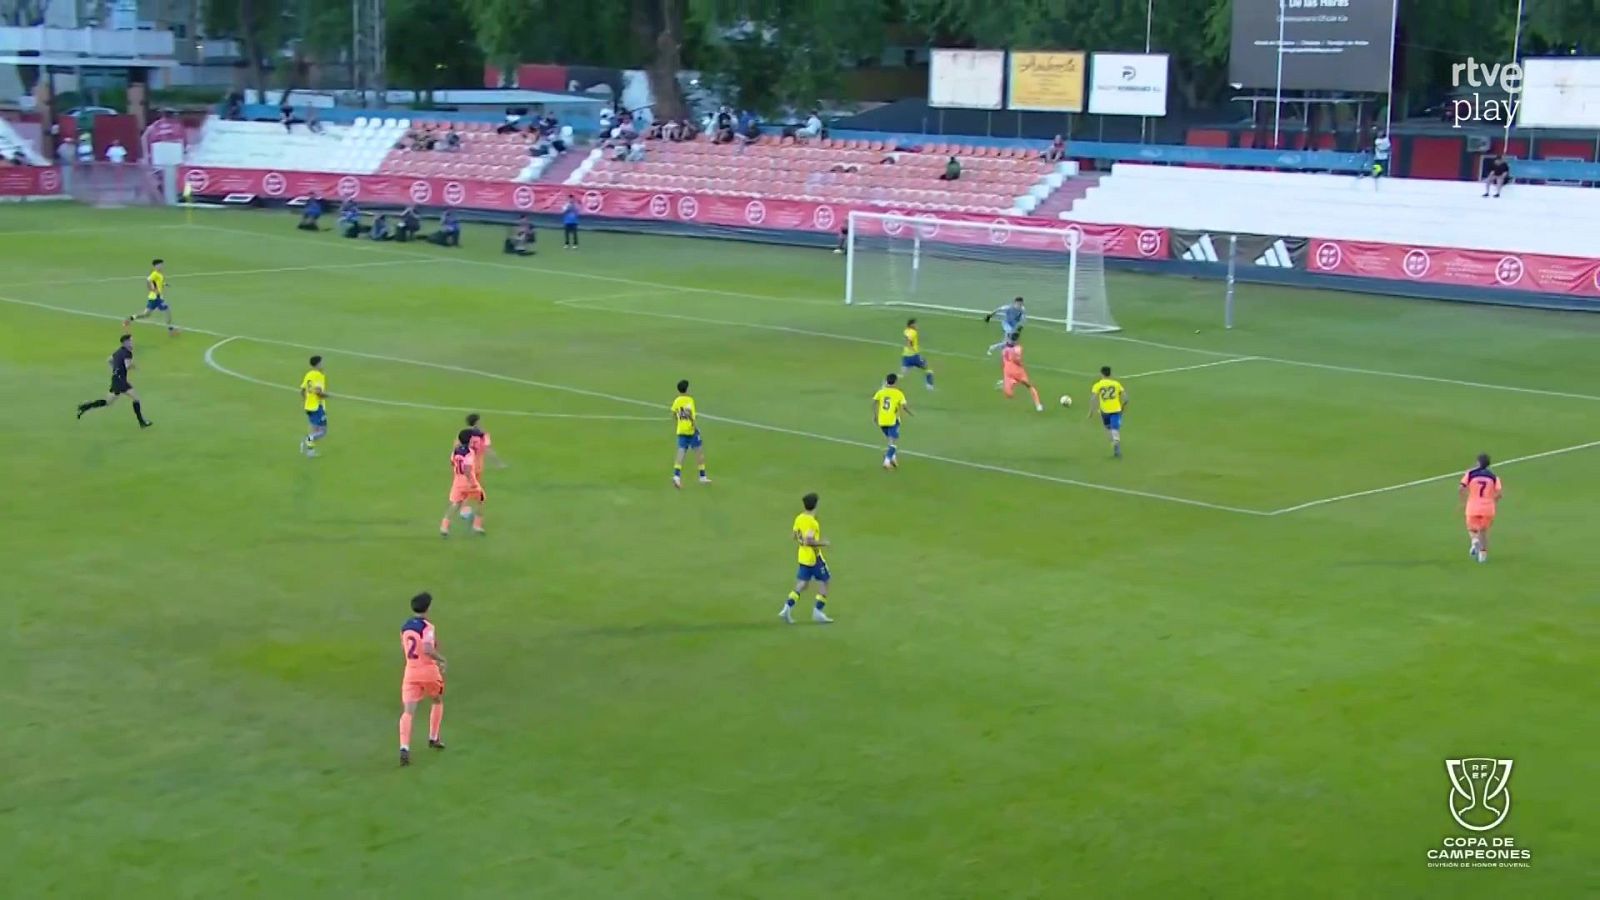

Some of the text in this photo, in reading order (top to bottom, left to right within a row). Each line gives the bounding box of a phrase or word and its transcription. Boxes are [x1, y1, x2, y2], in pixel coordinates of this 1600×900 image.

[1100, 386, 1116, 401] 22
[883, 396, 891, 411] 5
[1477, 481, 1487, 498] 7
[407, 635, 419, 659] 2
